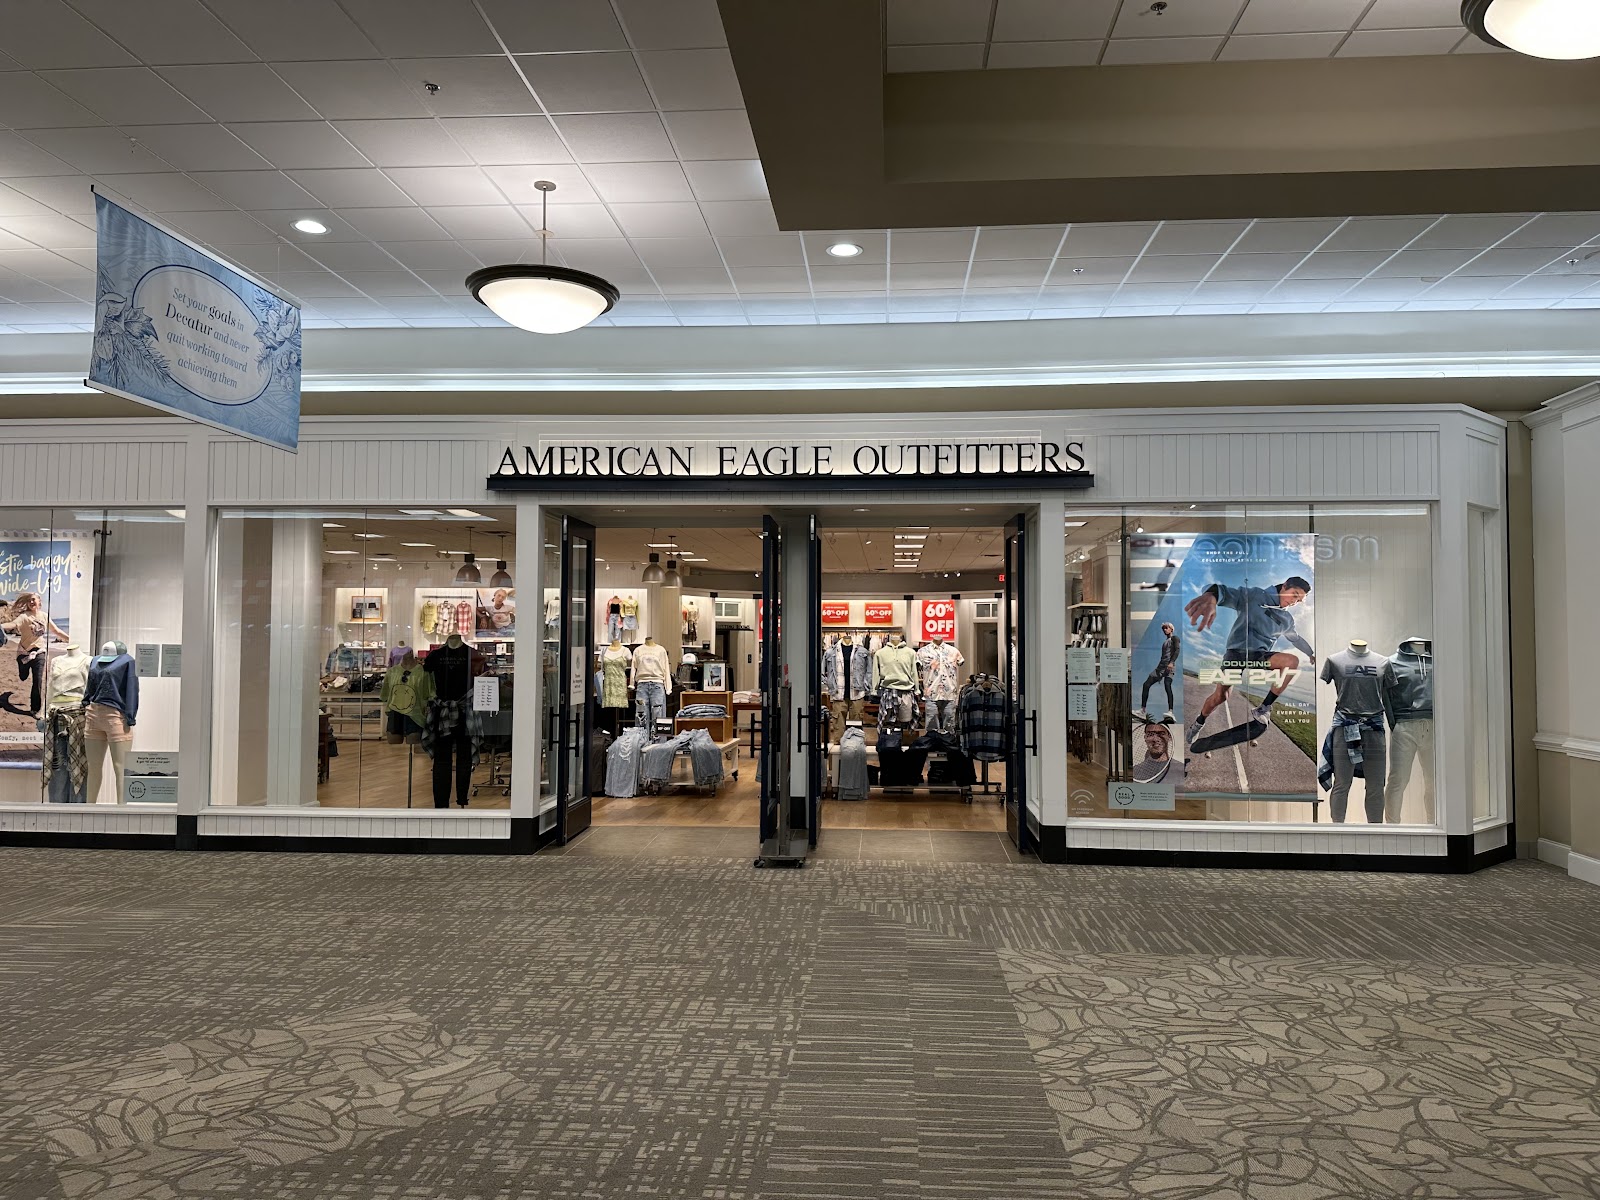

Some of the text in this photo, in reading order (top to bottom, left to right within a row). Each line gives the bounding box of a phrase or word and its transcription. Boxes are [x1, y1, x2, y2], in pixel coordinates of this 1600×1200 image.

[173, 288, 244, 332] Set your goals in
[165, 303, 250, 354] Decatur and never
[166, 331, 248, 373] quit working toward
[178, 358, 238, 389] achieving them
[491, 442, 1085, 476] AMERICAN EAGLE OUTFITTERS
[30, 552, 72, 576] baggy
[925, 604, 954, 618] 60%
[925, 620, 954, 632] OFF
[1199, 667, 1302, 688] AE 24/7
